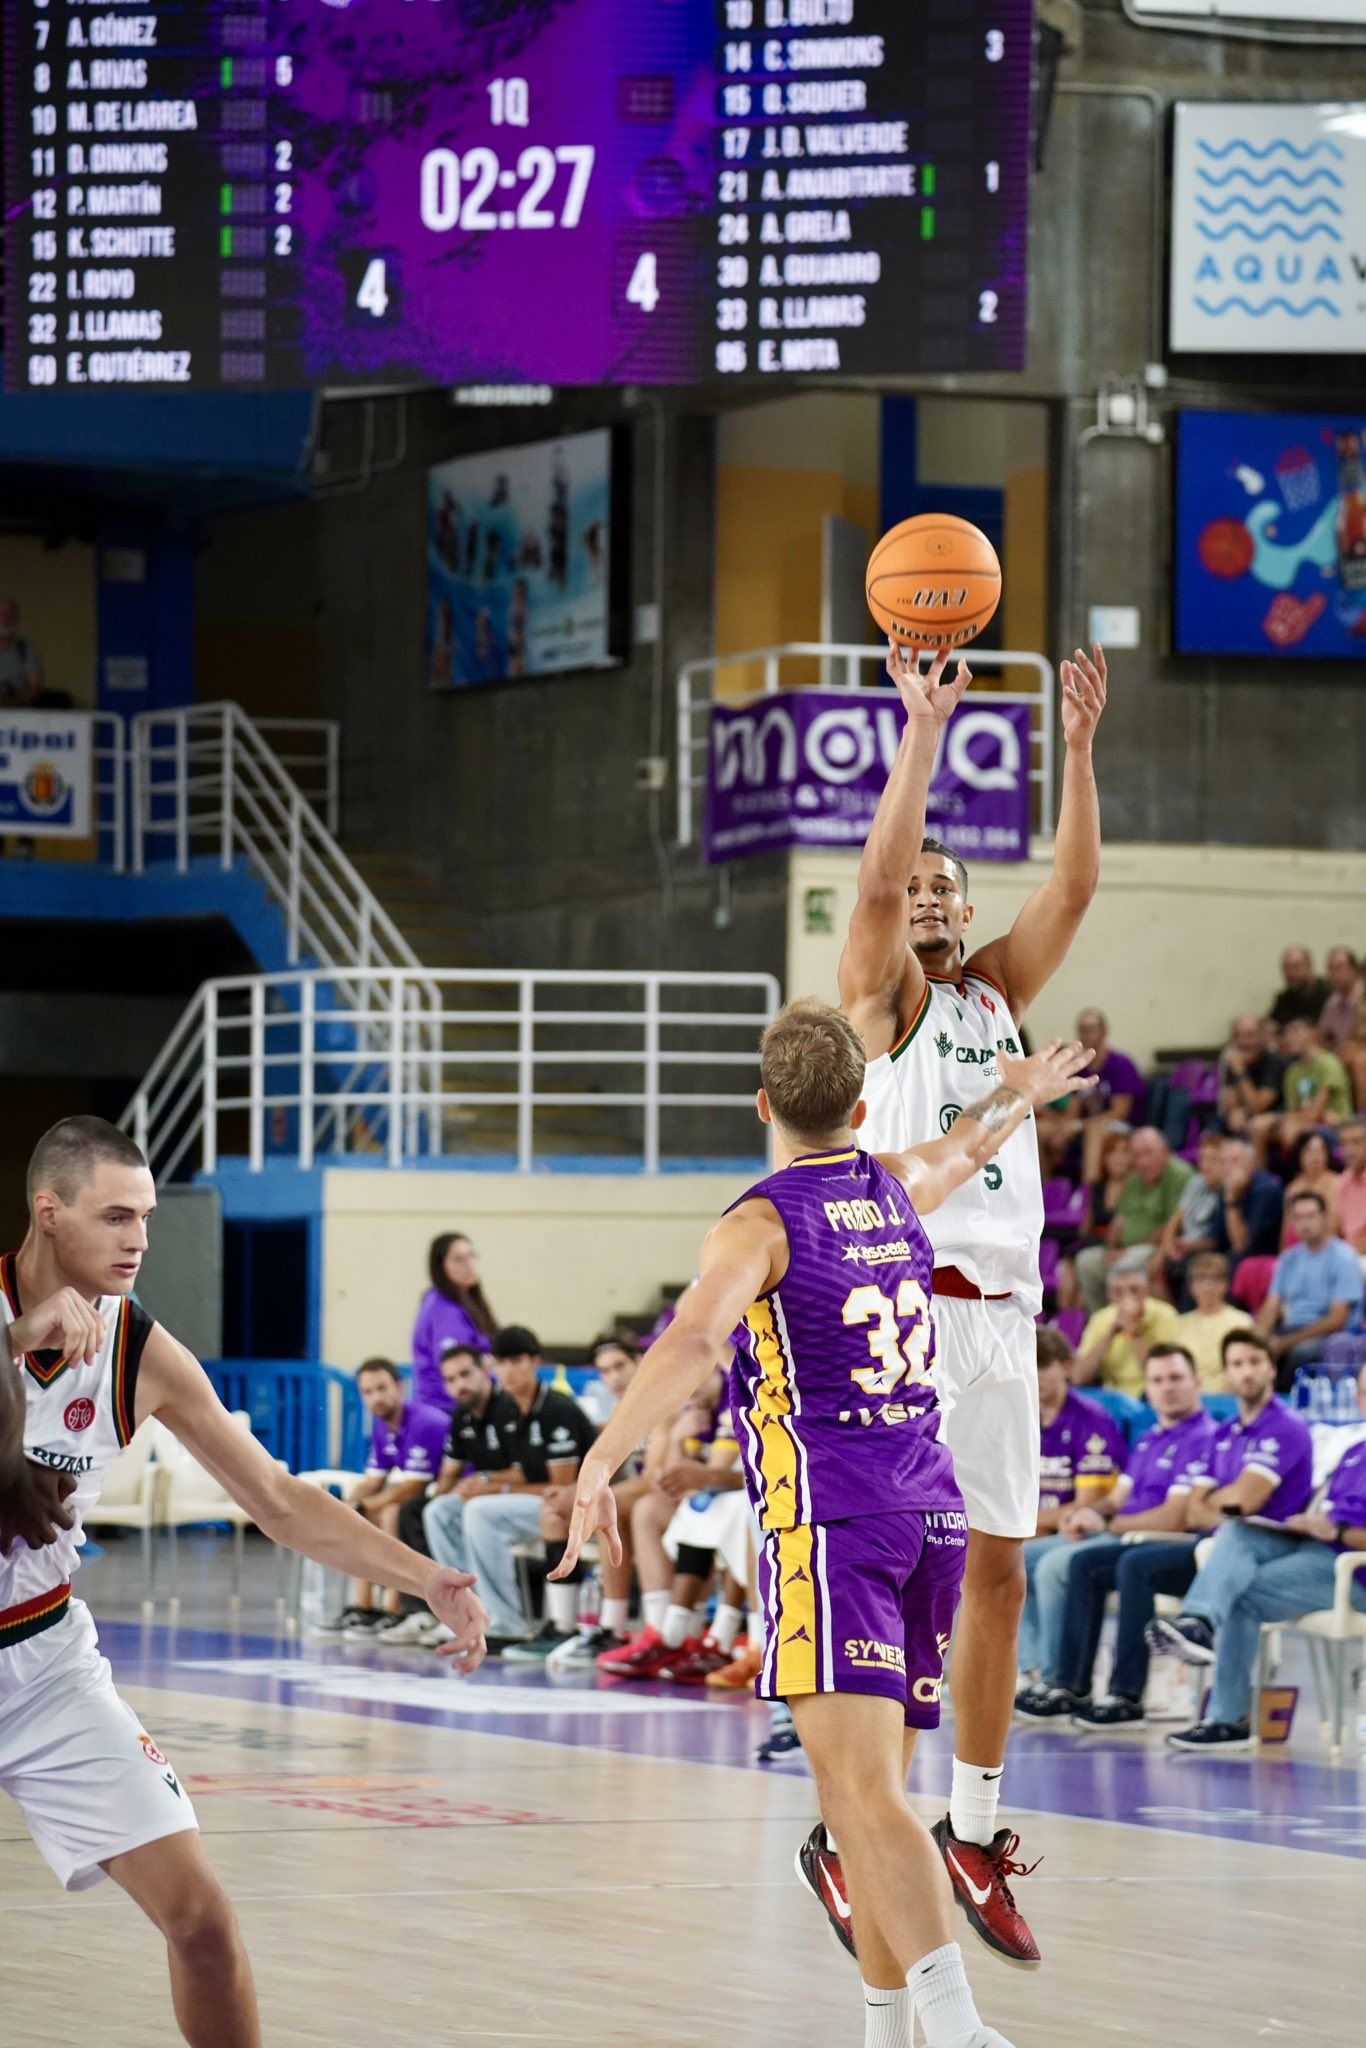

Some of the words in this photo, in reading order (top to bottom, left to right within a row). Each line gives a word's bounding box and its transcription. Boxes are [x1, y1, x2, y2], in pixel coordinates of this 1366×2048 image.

[35, 21, 50, 50] 7
[67, 17, 89, 47] A.
[725, 41, 752, 72] 14
[763, 40, 787, 71] C.
[986, 30, 1004, 62] 3
[67, 60, 89, 89] A.
[90, 59, 148, 89] RIVAS
[32, 105, 57, 135] 10
[67, 102, 93, 131] M.
[94, 101, 120, 131] DE
[122, 100, 198, 131] LARREA
[487, 77, 529, 127] 1Q
[32, 149, 55, 176] 11
[275, 140, 293, 172] 2
[724, 128, 751, 159] 17
[420, 145, 596, 232] 02:27
[718, 170, 748, 203] 21
[985, 161, 999, 193] 1
[32, 188, 57, 219] 12
[67, 186, 86, 215] P.
[275, 183, 293, 213] 2
[32, 231, 57, 260] 15
[67, 229, 88, 257] K.
[275, 224, 293, 256] 2
[718, 213, 749, 245] 24
[29, 273, 57, 302] 22
[356, 258, 389, 317] 4
[626, 252, 660, 312] 4
[29, 314, 57, 344] 32
[67, 311, 84, 341] J.
[85, 310, 163, 341] LLAMAS
[716, 298, 748, 330] 33
[979, 290, 999, 323] 2
[67, 351, 88, 382] E.
[758, 340, 781, 372] E.
[886, 1194, 906, 1226] J.
[841, 1279, 937, 1395] 32
